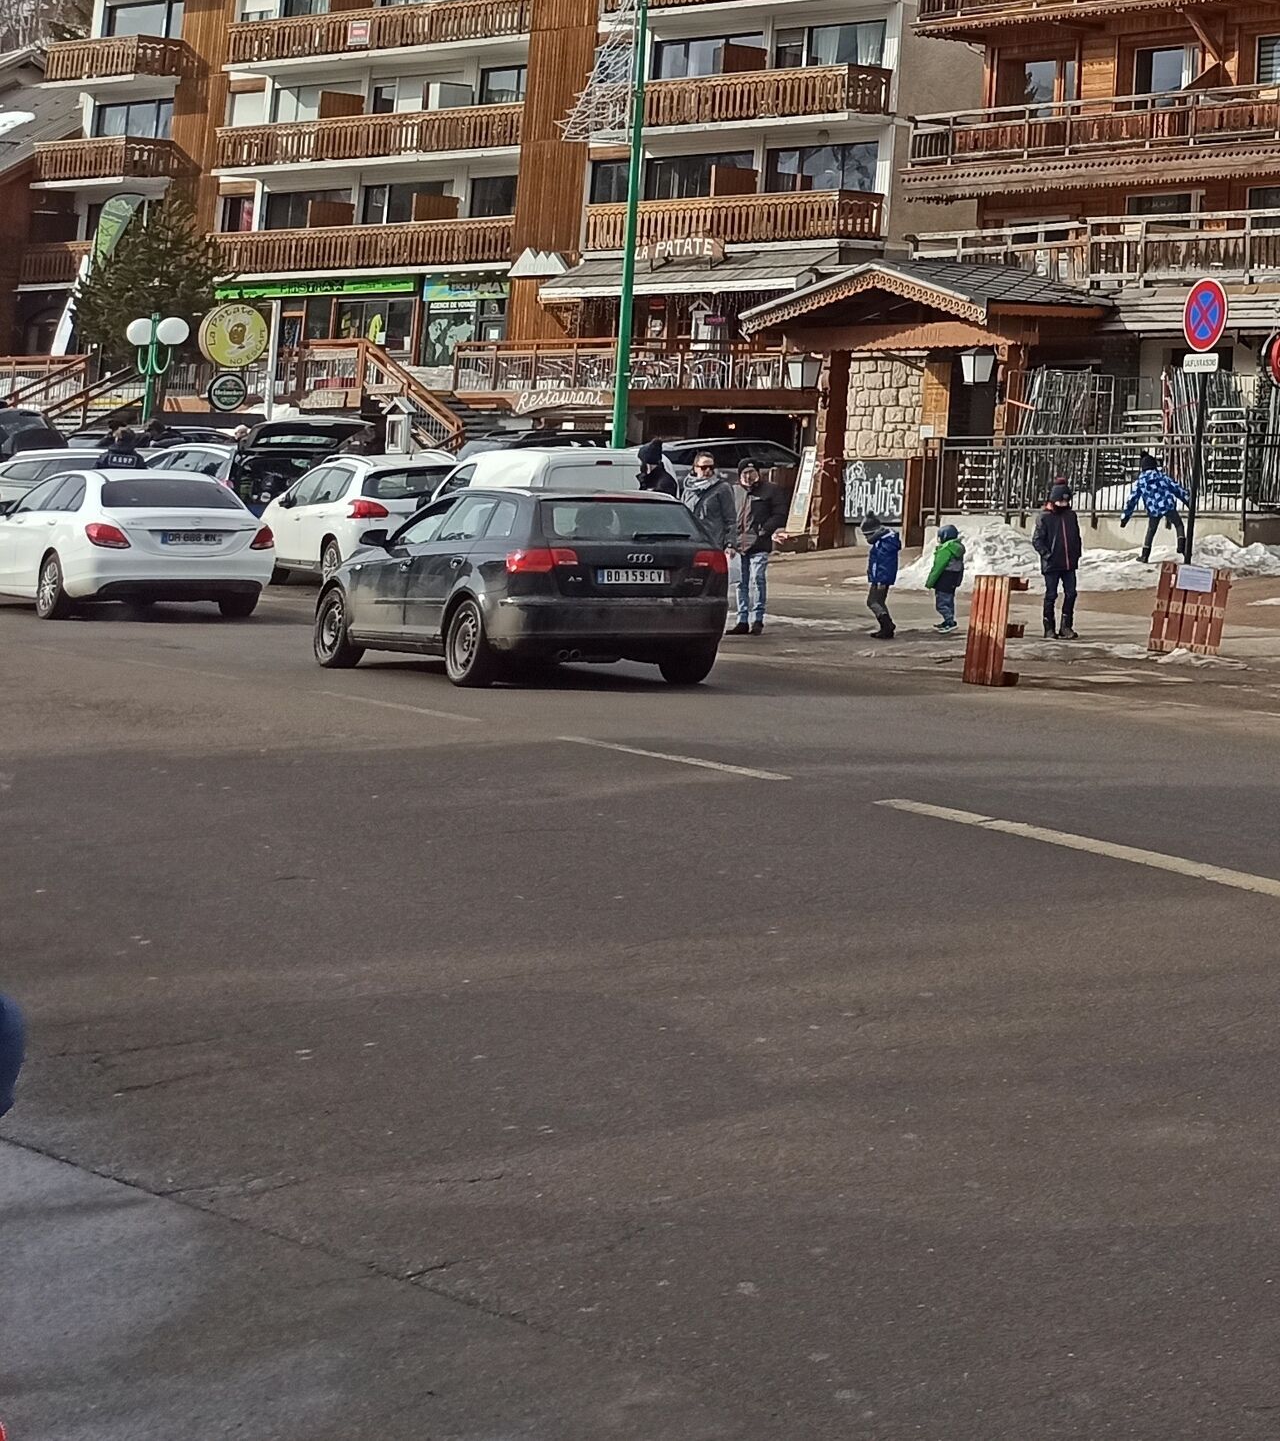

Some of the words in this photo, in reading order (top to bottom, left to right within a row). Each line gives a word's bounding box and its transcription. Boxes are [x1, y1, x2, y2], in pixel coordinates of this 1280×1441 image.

[635, 248, 648, 260] LA
[655, 238, 714, 258] PATATE
[429, 301, 450, 309] AGENCE
[458, 300, 477, 308] VOYAGE
[211, 306, 255, 328] Patate
[207, 331, 217, 346] La
[229, 357, 243, 365] NO
[516, 390, 603, 413] Restaurant
